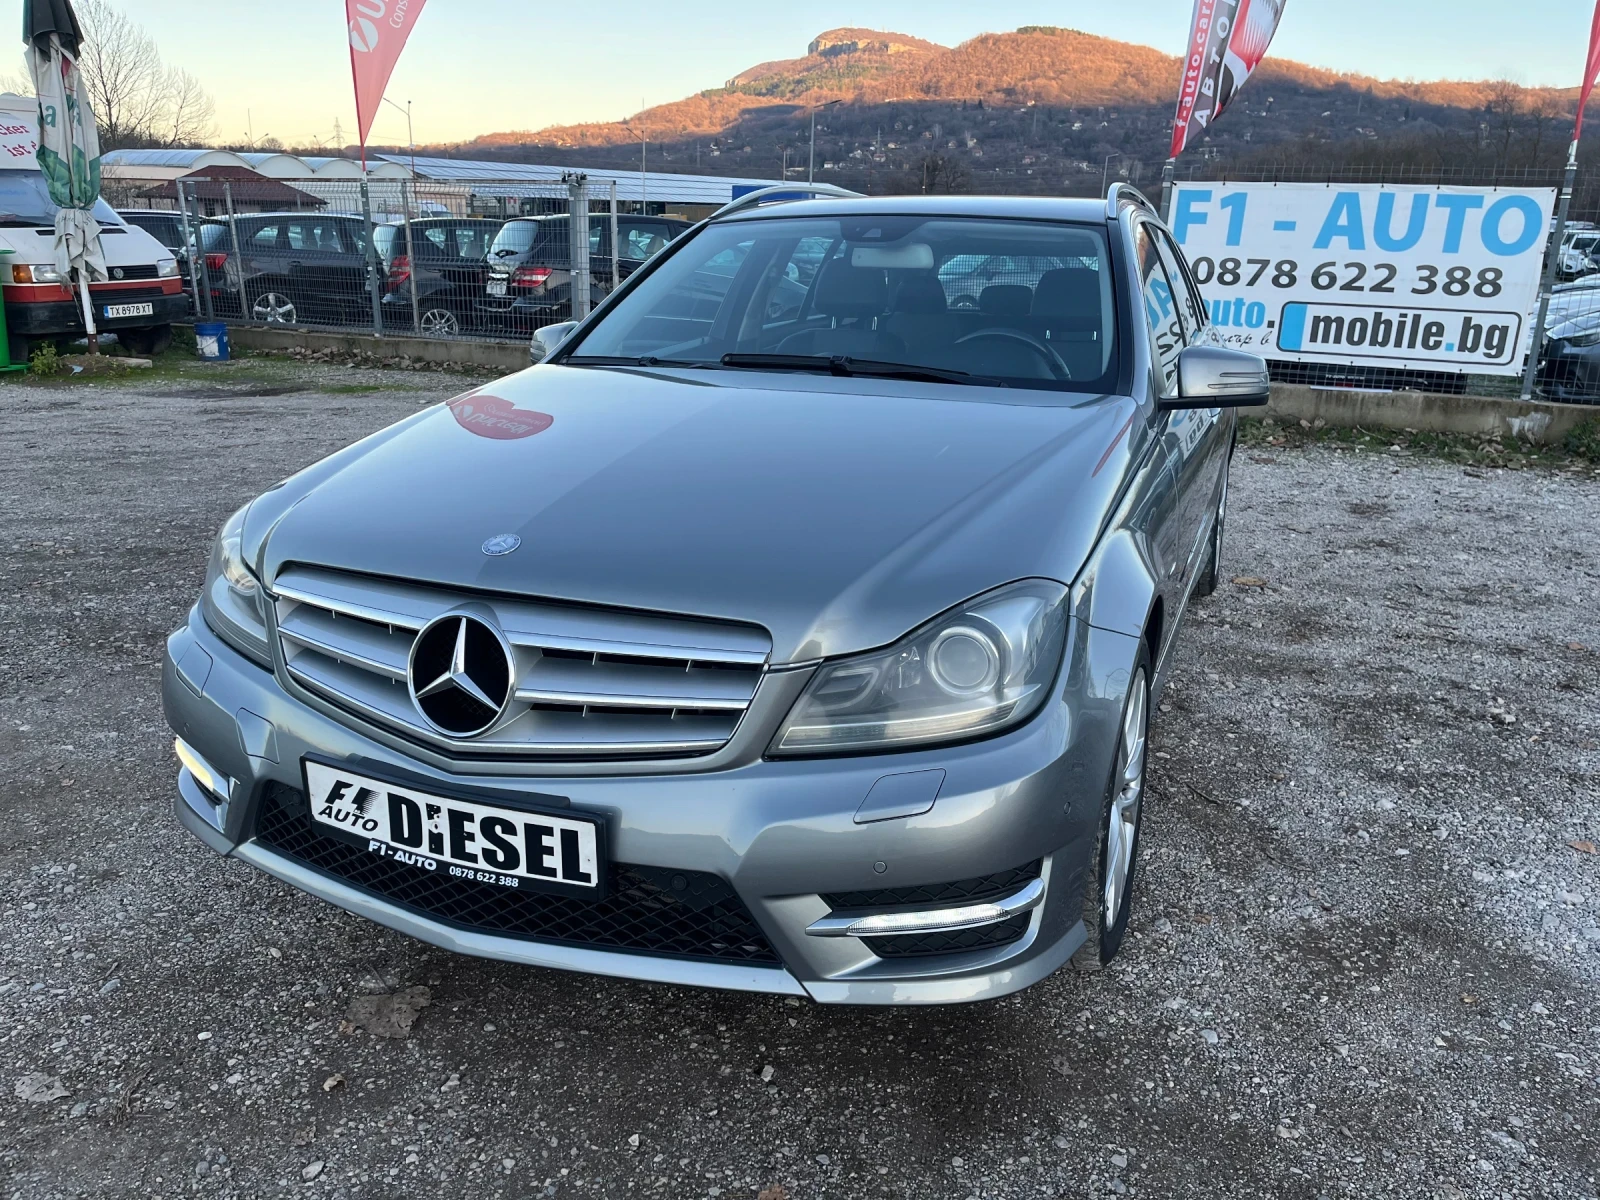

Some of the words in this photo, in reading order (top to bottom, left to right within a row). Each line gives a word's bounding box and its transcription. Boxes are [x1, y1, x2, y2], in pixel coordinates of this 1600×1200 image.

[356, 0, 386, 19] U
[1174, 190, 1248, 247] F1
[1312, 191, 1543, 257] AUTO
[1191, 256, 1298, 288] 0878
[1311, 261, 1398, 293] 622
[1411, 264, 1504, 298] 388
[121, 304, 141, 316] 8978
[1309, 311, 1510, 359] mobile.bg
[318, 804, 379, 832] AUTO
[449, 866, 475, 880] 0878
[476, 872, 496, 884] 622
[498, 875, 519, 888] 388
